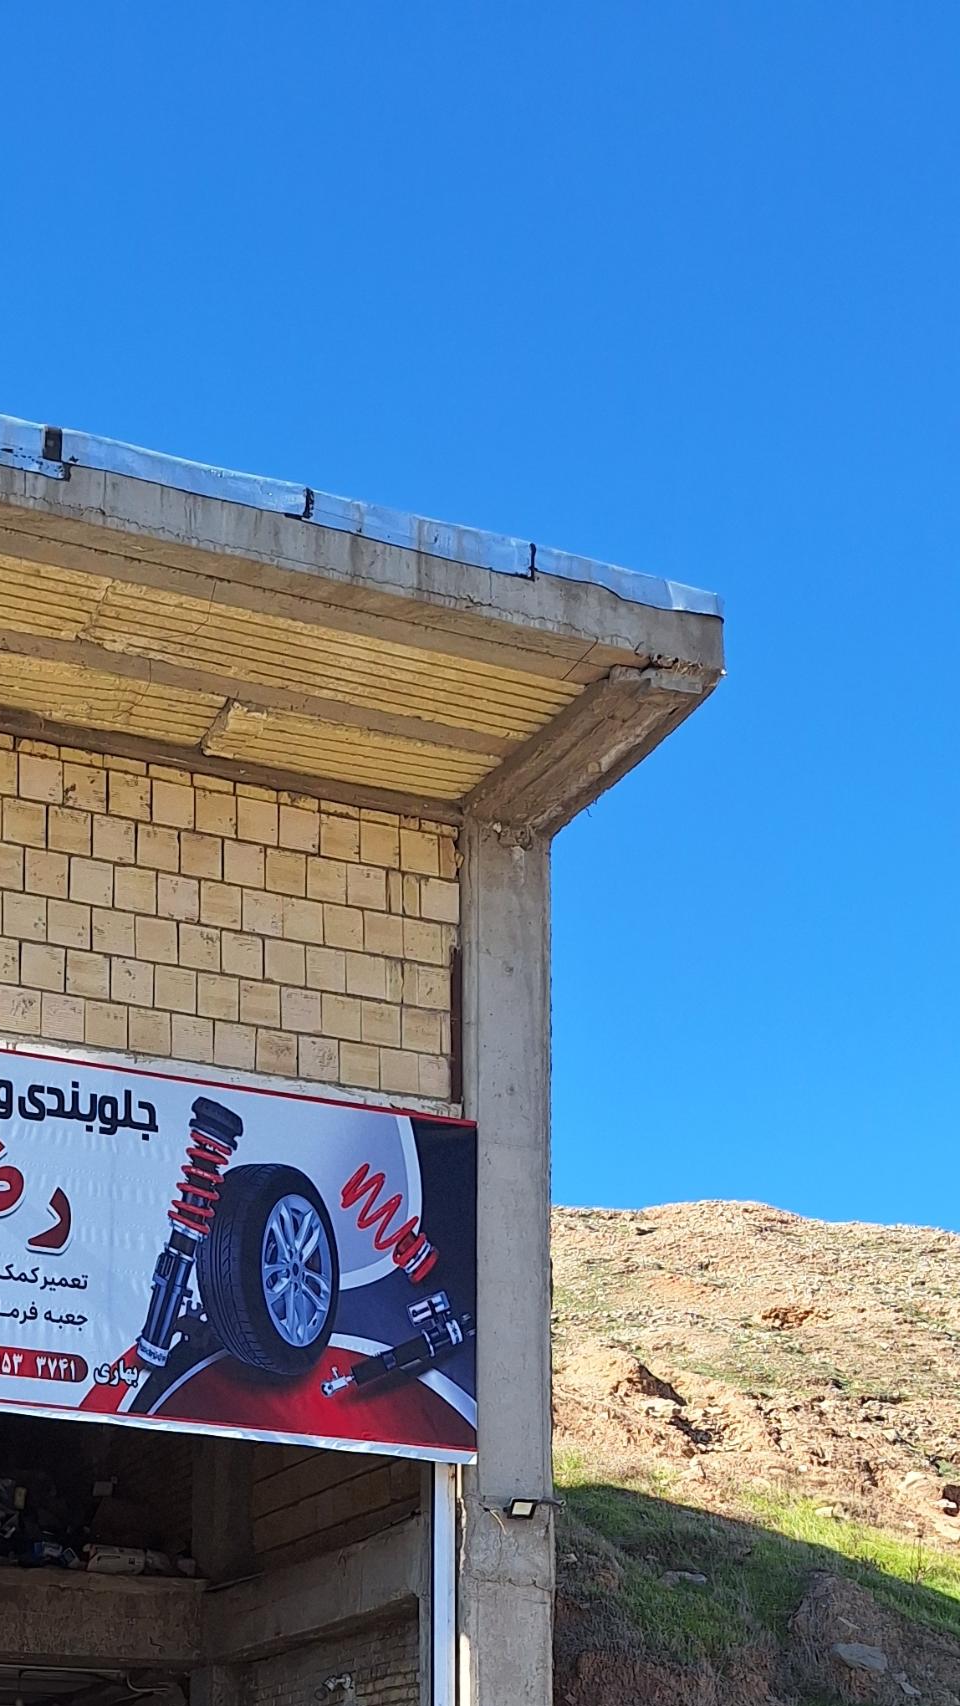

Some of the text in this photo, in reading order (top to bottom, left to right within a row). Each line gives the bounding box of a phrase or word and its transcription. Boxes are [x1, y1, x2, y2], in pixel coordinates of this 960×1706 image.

[18, 1081, 159, 1141] جلوبندی
[40, 1273, 89, 1292] تعمیر
[43, 1309, 89, 1331] جعبه
[35, 1355, 77, 1381] ۳۷۴۱
[94, 1357, 140, 1387] بهاری
